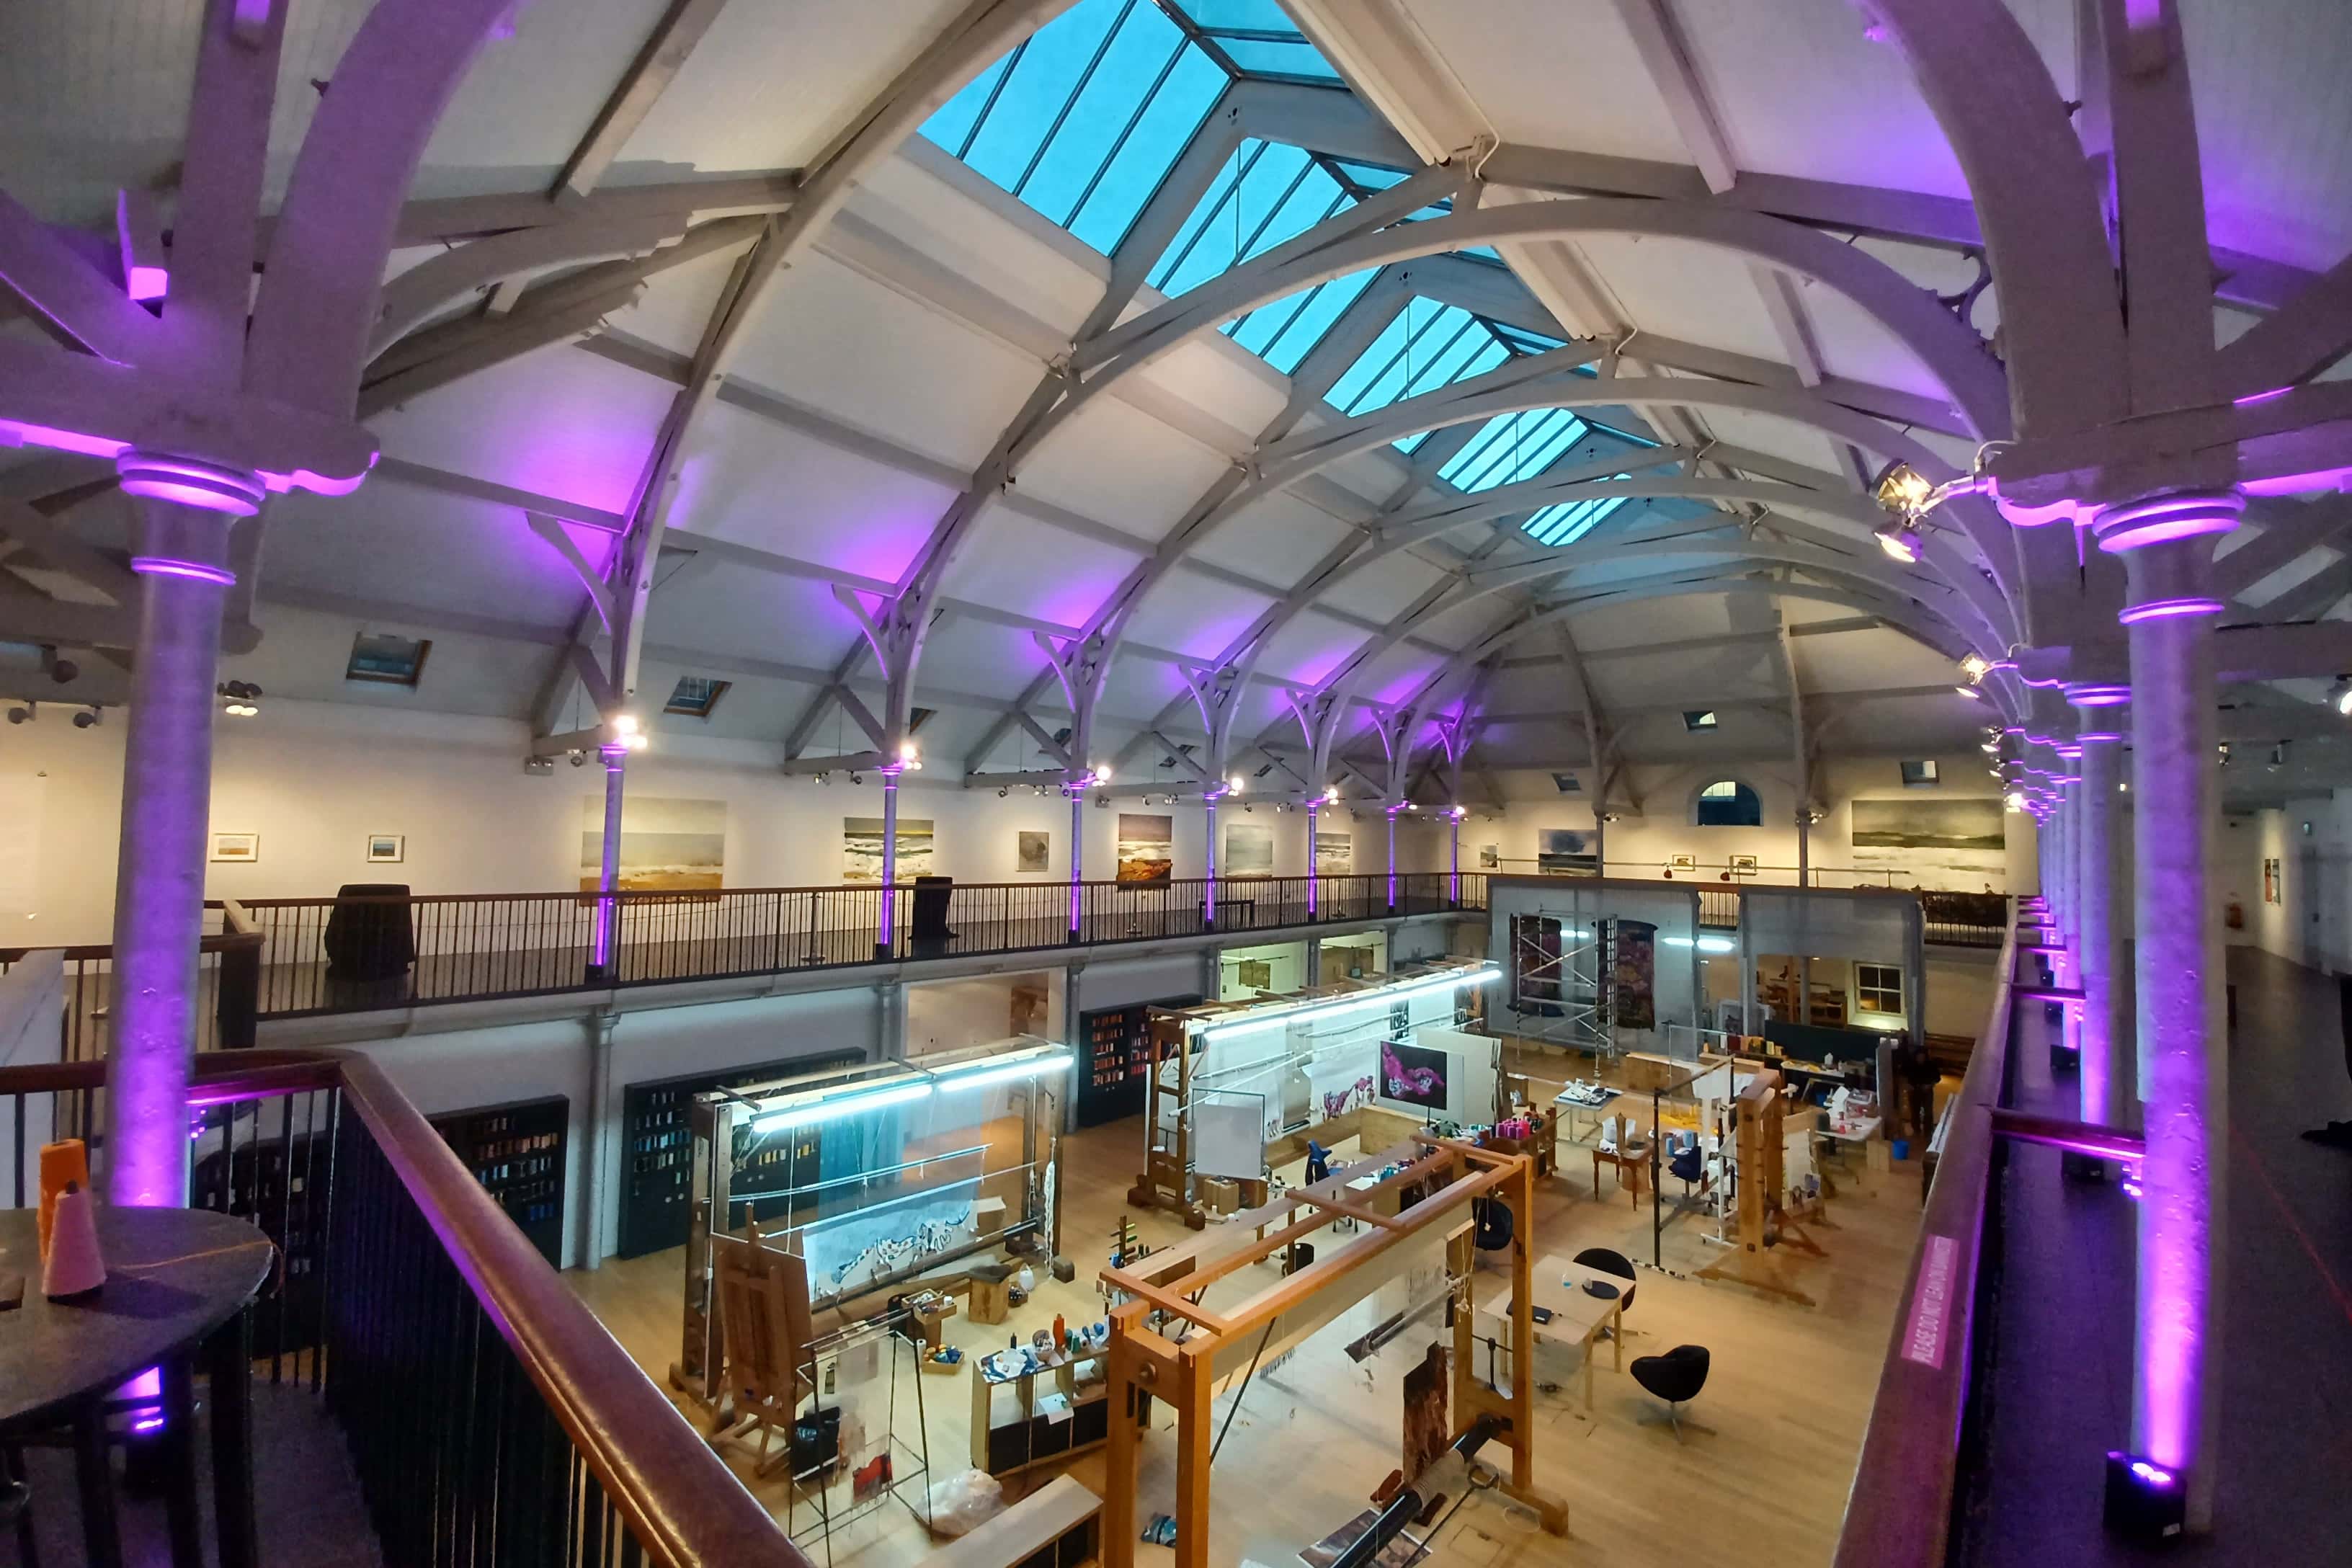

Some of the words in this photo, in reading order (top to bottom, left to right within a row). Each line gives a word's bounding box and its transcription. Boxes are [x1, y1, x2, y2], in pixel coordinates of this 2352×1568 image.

[1924, 1278, 1945, 1300] LEAN
[1920, 1298, 1942, 1317] NOT
[1917, 1315, 1939, 1332] DO
[1912, 1328, 1936, 1364] PLEASE
